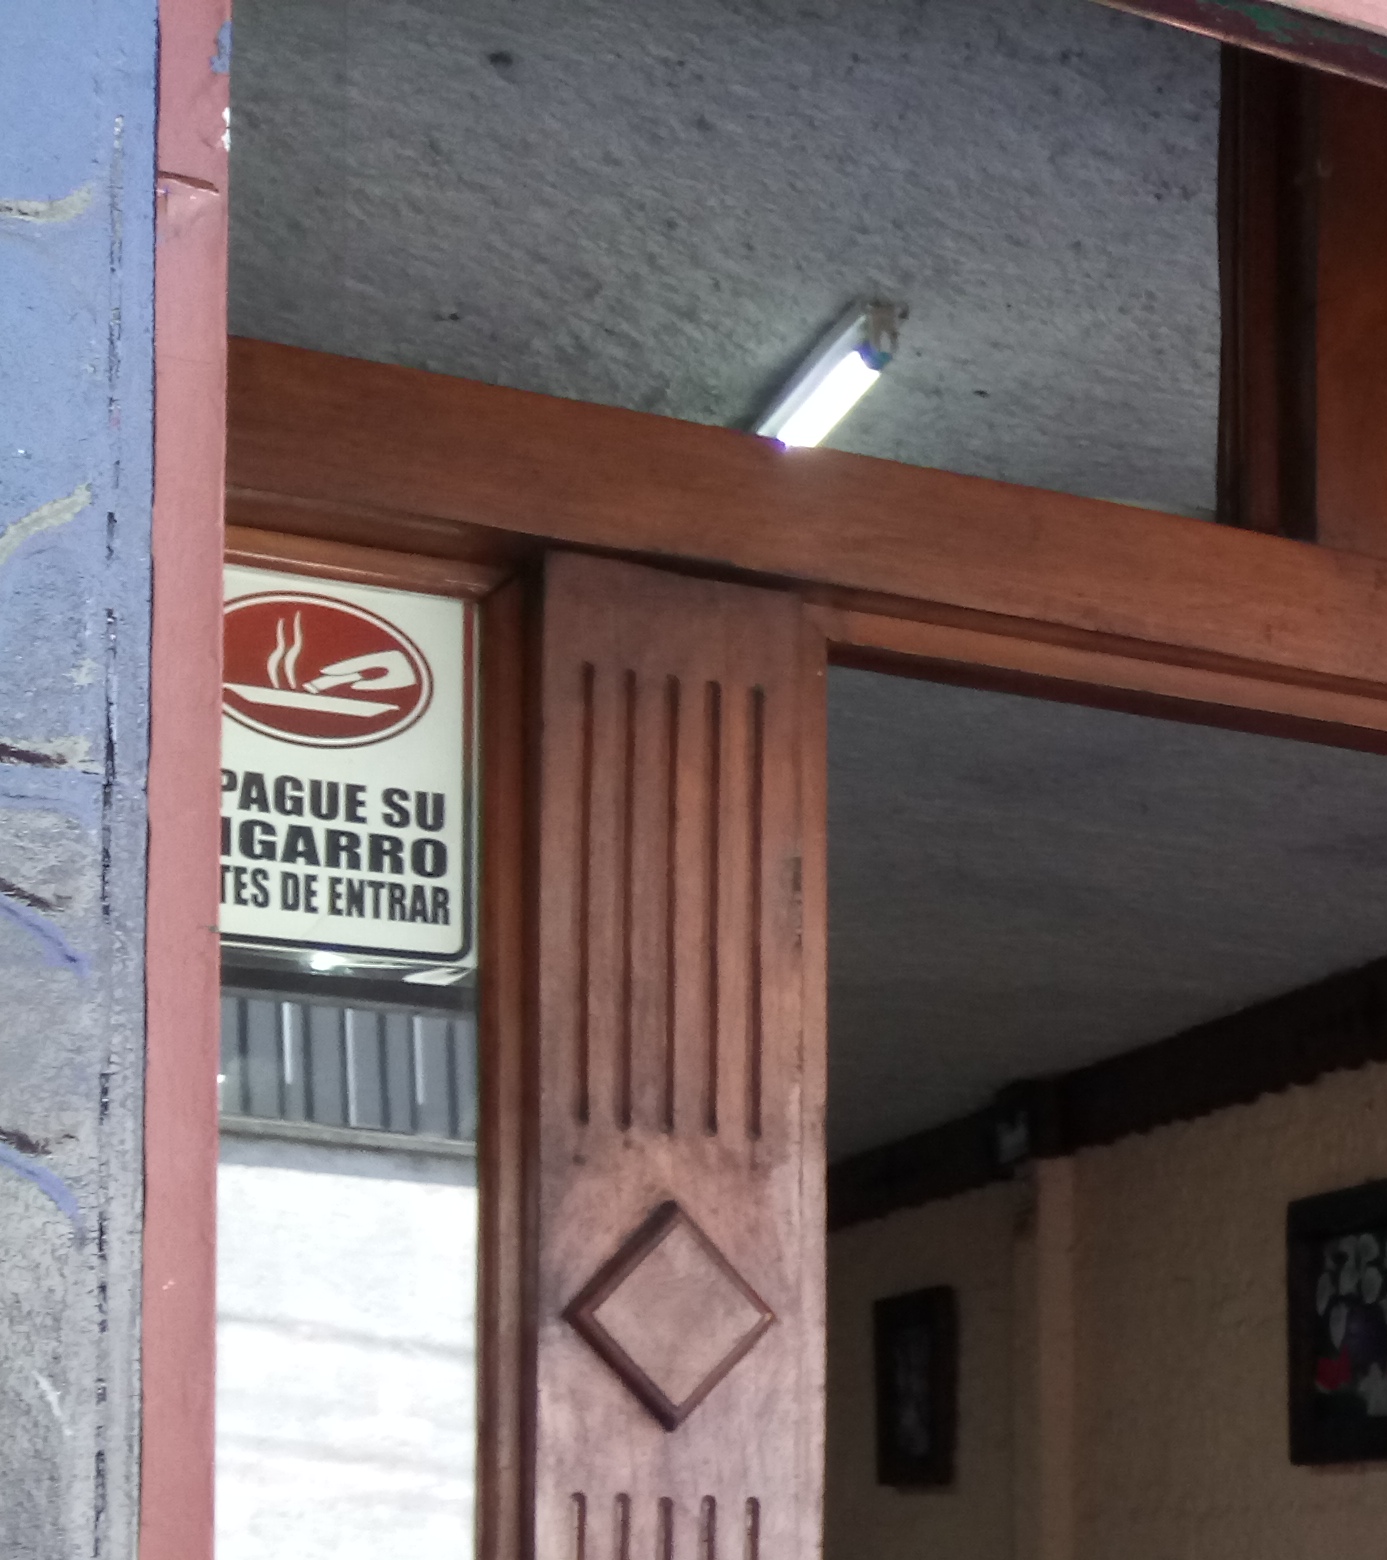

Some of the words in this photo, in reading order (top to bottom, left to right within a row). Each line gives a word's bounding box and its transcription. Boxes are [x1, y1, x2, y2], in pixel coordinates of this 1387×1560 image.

[382, 788, 446, 832] SU
[281, 871, 319, 914] DE
[328, 876, 450, 926] ENTRAR
